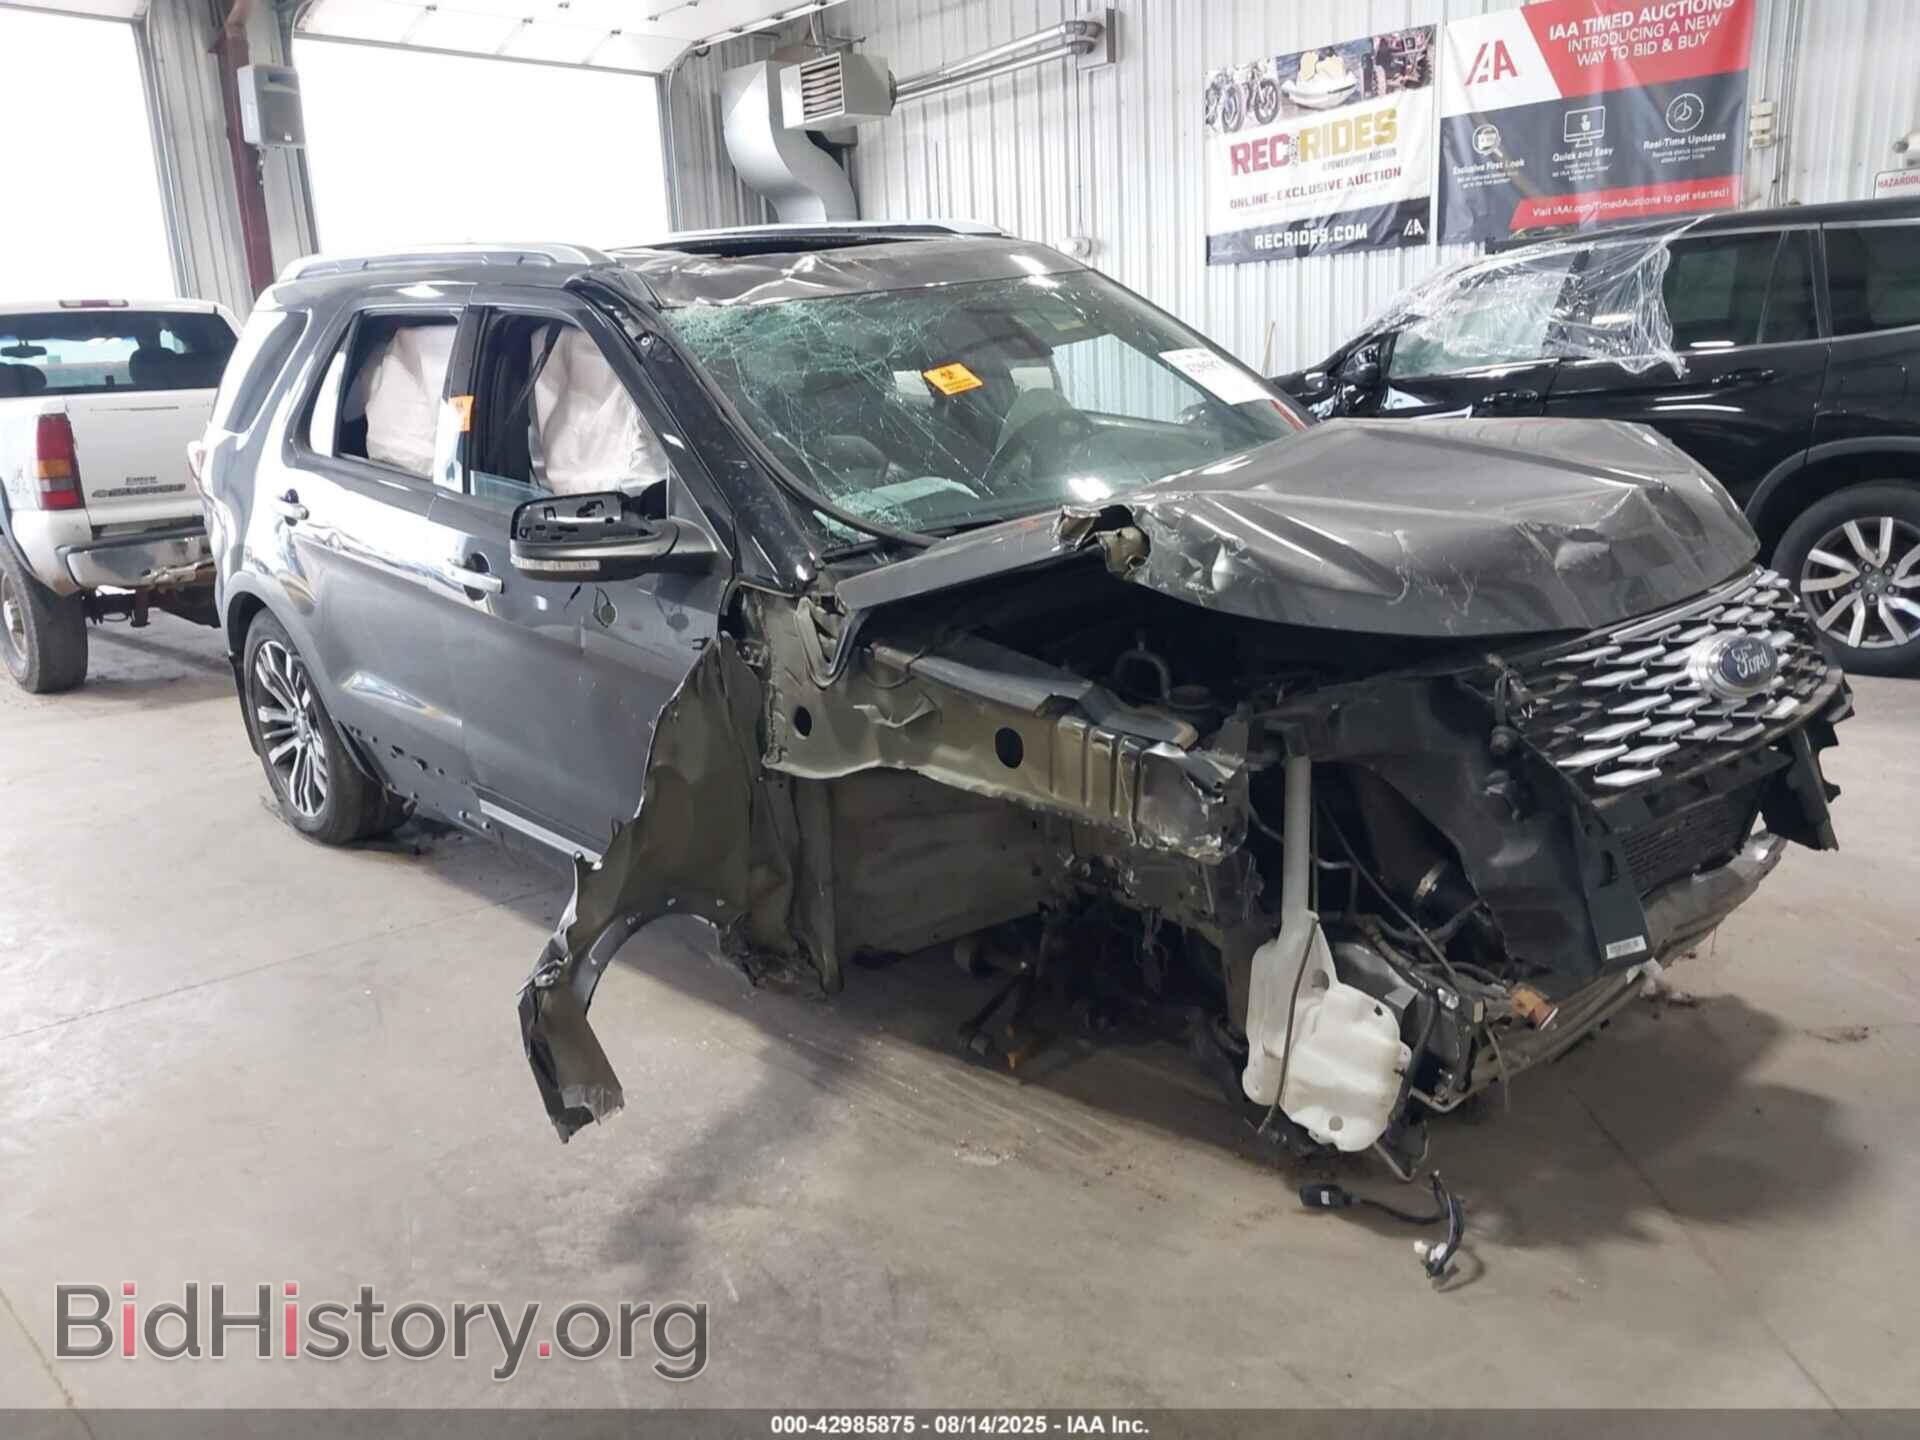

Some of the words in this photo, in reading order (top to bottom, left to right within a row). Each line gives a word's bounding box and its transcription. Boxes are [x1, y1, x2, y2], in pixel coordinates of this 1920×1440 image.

[1550, 21, 1579, 41] IAA
[1582, 11, 1634, 34] TIMED
[1567, 25, 1665, 53] INTRODUCING
[1668, 21, 1681, 35] A
[1684, 12, 1722, 31] NEW
[1577, 47, 1607, 67] WAY
[1610, 45, 1629, 61] TO
[1633, 40, 1658, 57] BID
[1661, 38, 1673, 53] &
[1678, 31, 1710, 50] BUY
[1230, 133, 1290, 176] REC
[1299, 108, 1398, 163] RIDES
[1552, 152, 1577, 163] Quick
[1577, 149, 1593, 160] and
[1594, 146, 1614, 157] Easy
[1643, 138, 1686, 151] Real-Time
[1687, 132, 1727, 145] Updates
[1346, 166, 1402, 187] AUCTION
[1452, 164, 1485, 176] Exclusive
[1486, 160, 1504, 171] First
[1504, 157, 1525, 169] Look
[1532, 207, 1552, 217] Visit
[1663, 194, 1672, 204] to
[1674, 192, 1690, 204] get
[1692, 188, 1729, 201] started!
[1254, 223, 1368, 251] RECRIDES.COM
[1731, 644, 1770, 679] Ford
